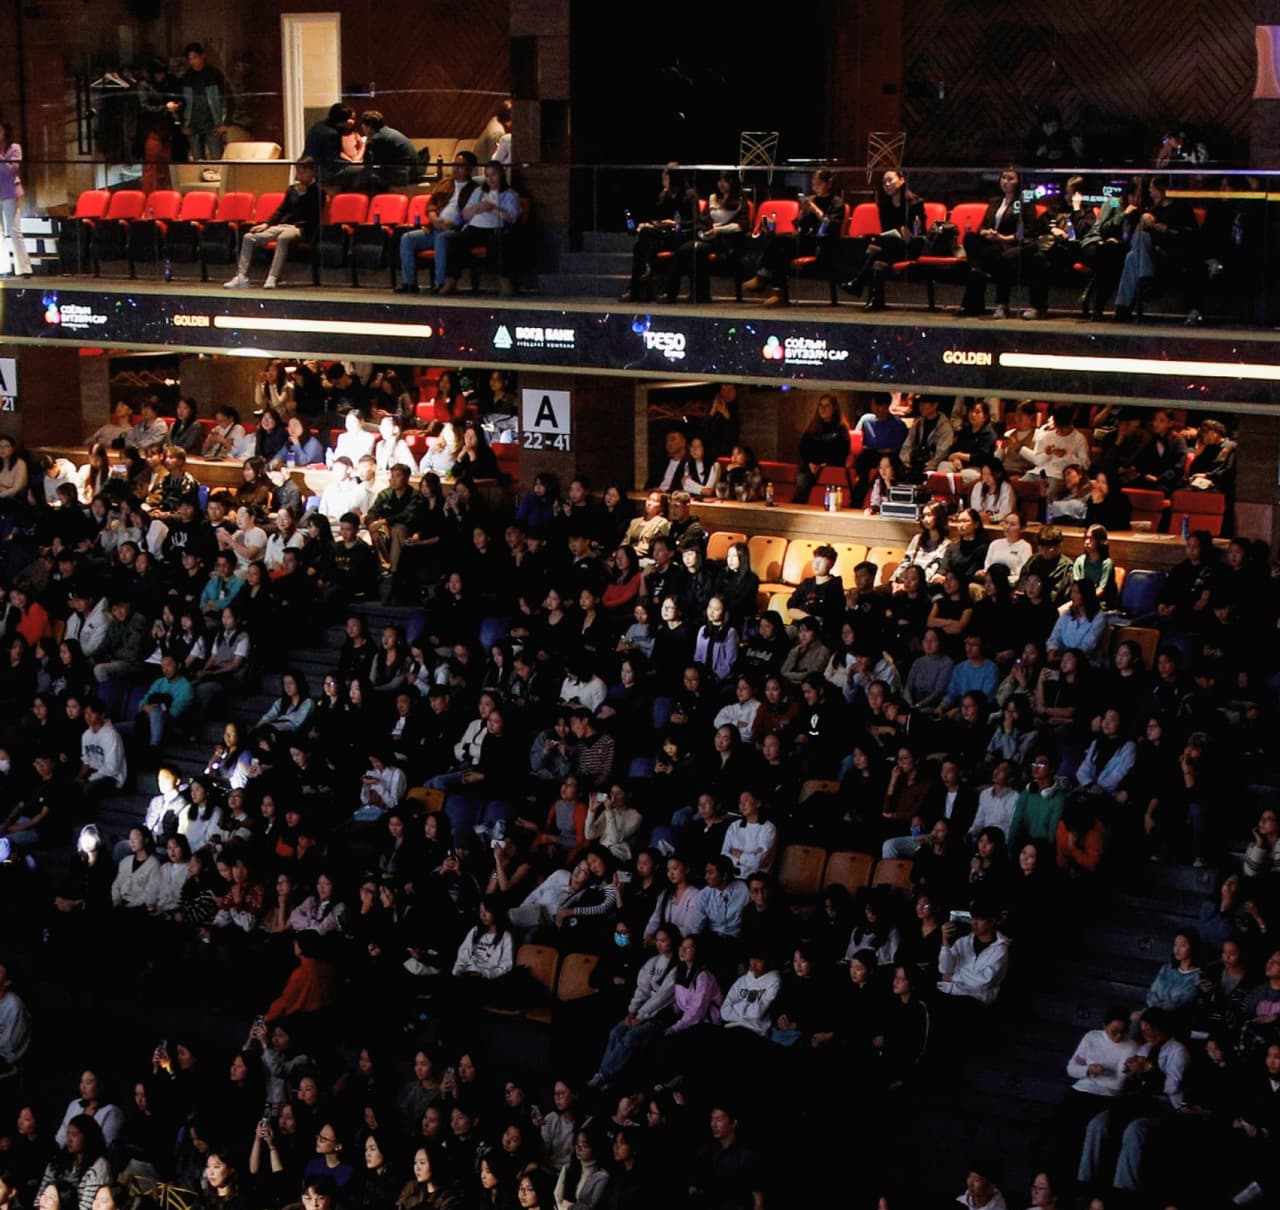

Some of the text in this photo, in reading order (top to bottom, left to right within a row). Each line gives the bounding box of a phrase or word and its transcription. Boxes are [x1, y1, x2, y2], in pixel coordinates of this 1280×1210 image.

[173, 315, 209, 327] GOLDEN
[644, 331, 685, 350] TESO
[828, 350, 848, 360] САР
[943, 351, 991, 365] GOLDEN
[534, 395, 559, 428] A
[523, 432, 570, 451] 22-41
